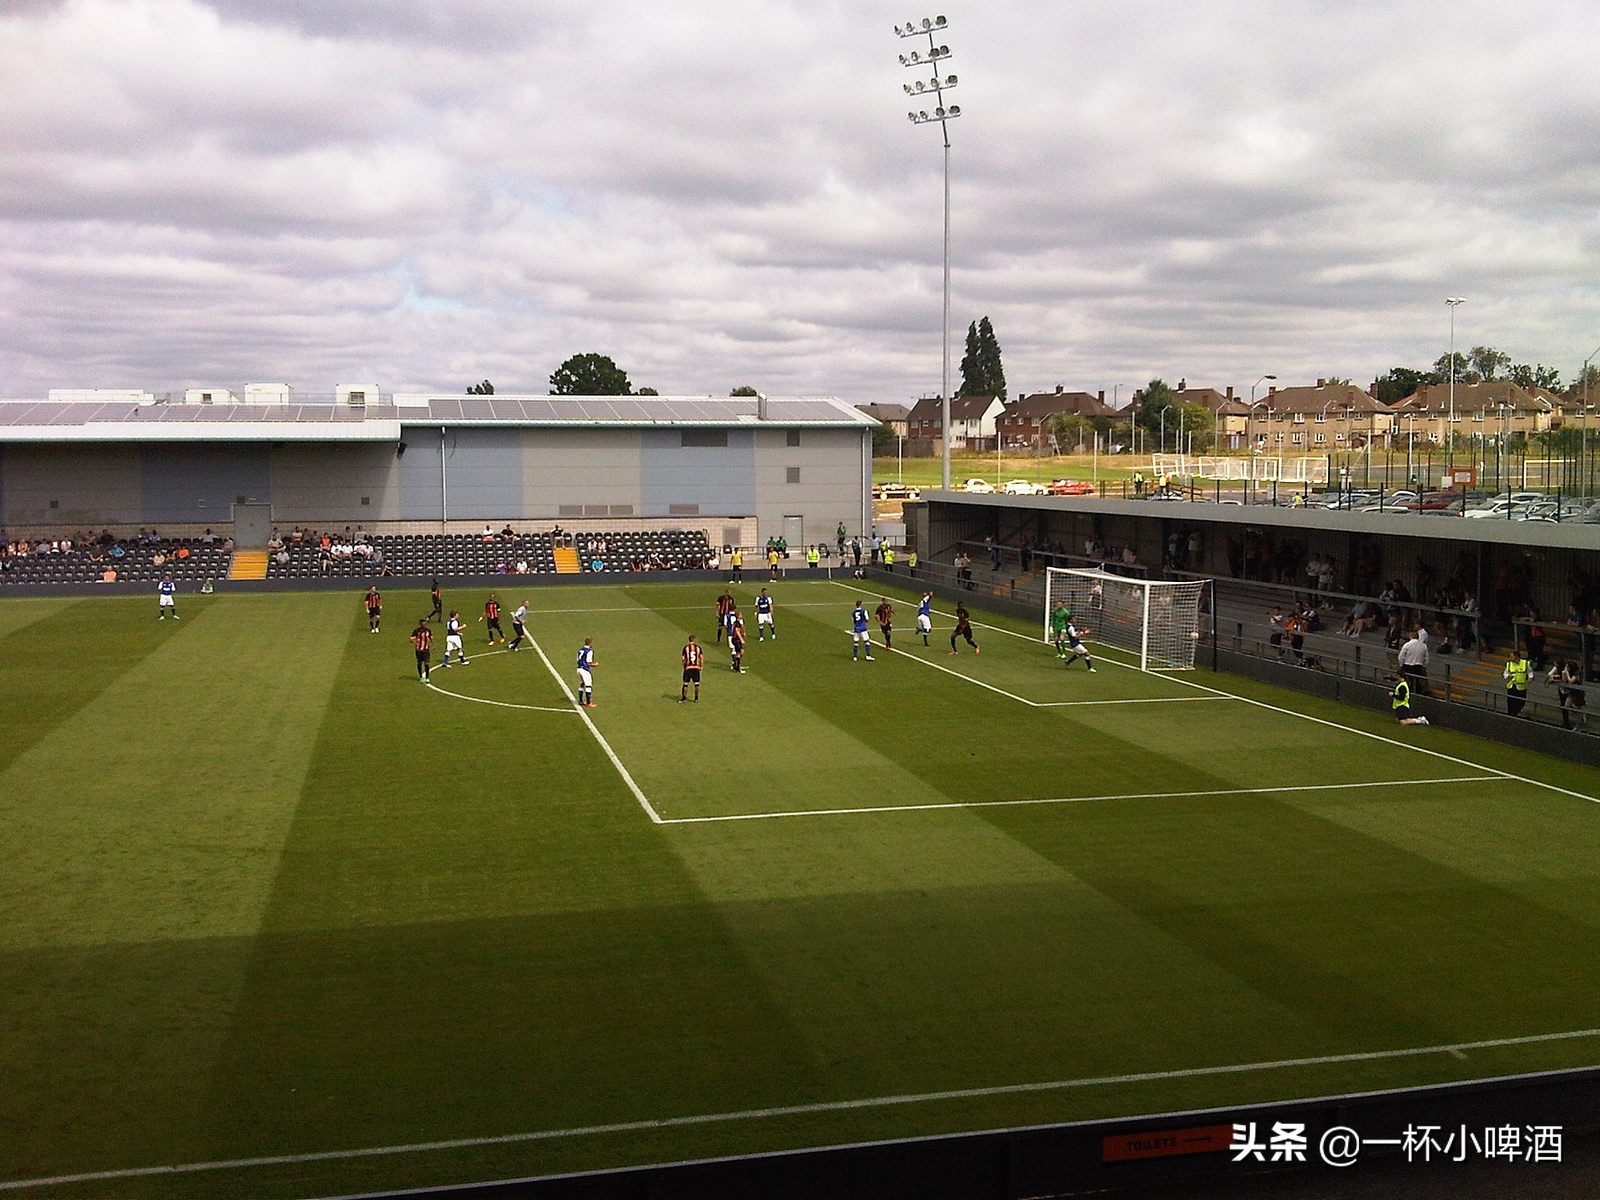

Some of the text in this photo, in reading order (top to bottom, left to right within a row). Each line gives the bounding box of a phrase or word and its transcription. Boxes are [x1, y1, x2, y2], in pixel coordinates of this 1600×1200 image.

[854, 611, 861, 621] 5
[689, 651, 697, 662] 5
[1127, 1137, 1177, 1152] TOILETS
